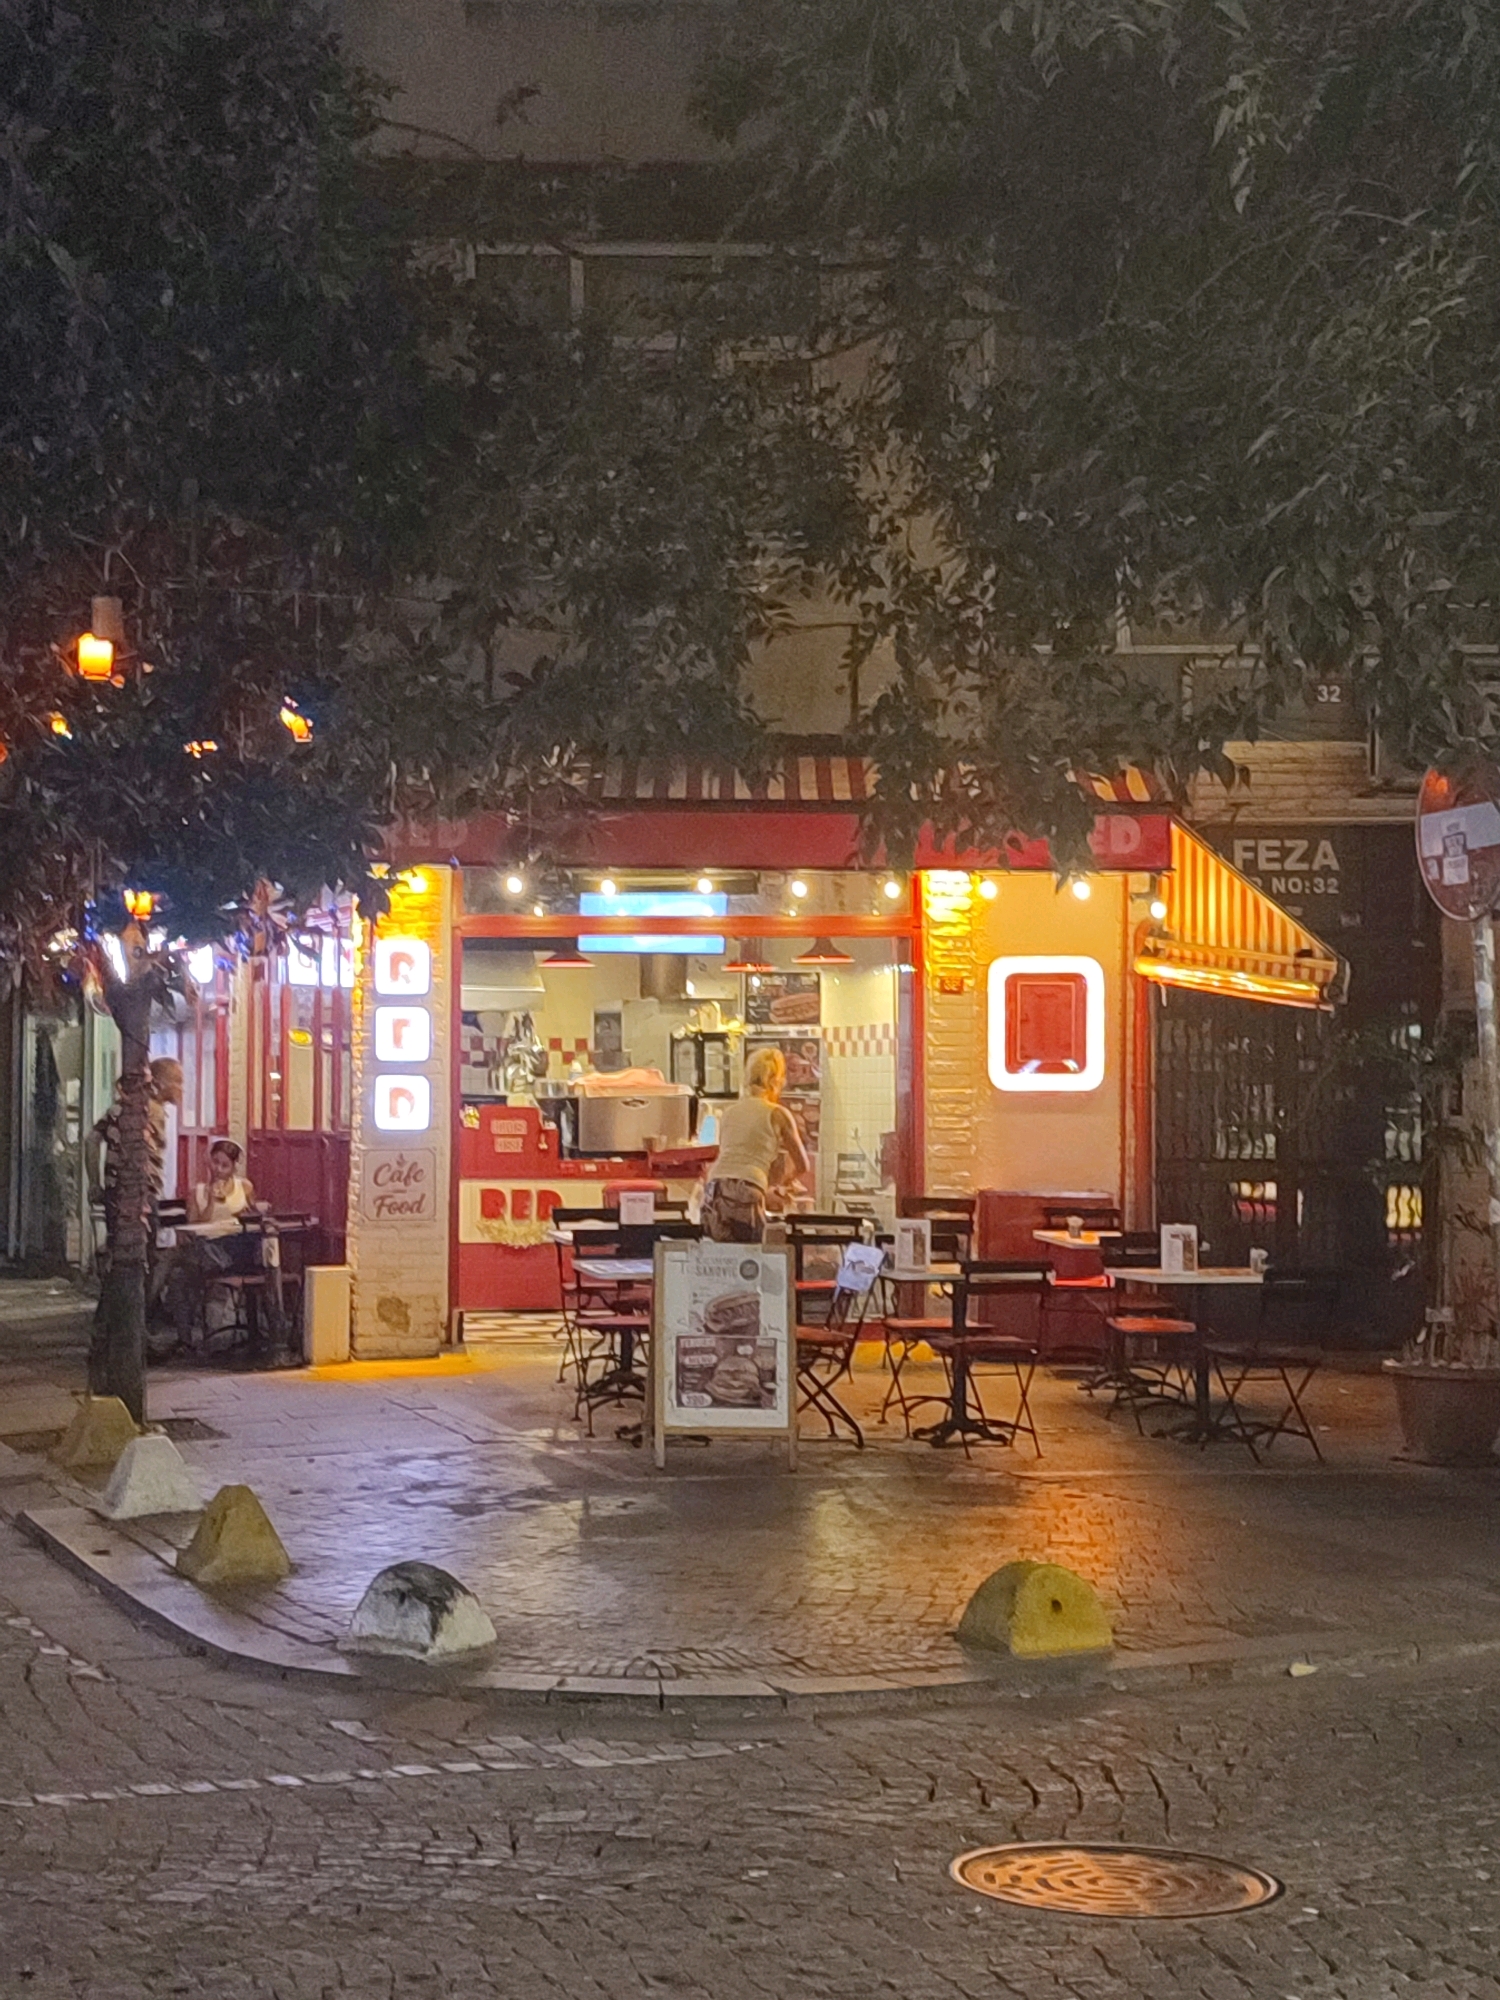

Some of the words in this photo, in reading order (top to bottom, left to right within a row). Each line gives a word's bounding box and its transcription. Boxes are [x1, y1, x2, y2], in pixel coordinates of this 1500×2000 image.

[1317, 684, 1342, 703] 32
[1233, 838, 1341, 872] FEZA
[1271, 877, 1340, 896] NO:32
[373, 1193, 427, 1219] Food
[480, 1188, 564, 1221] RED
